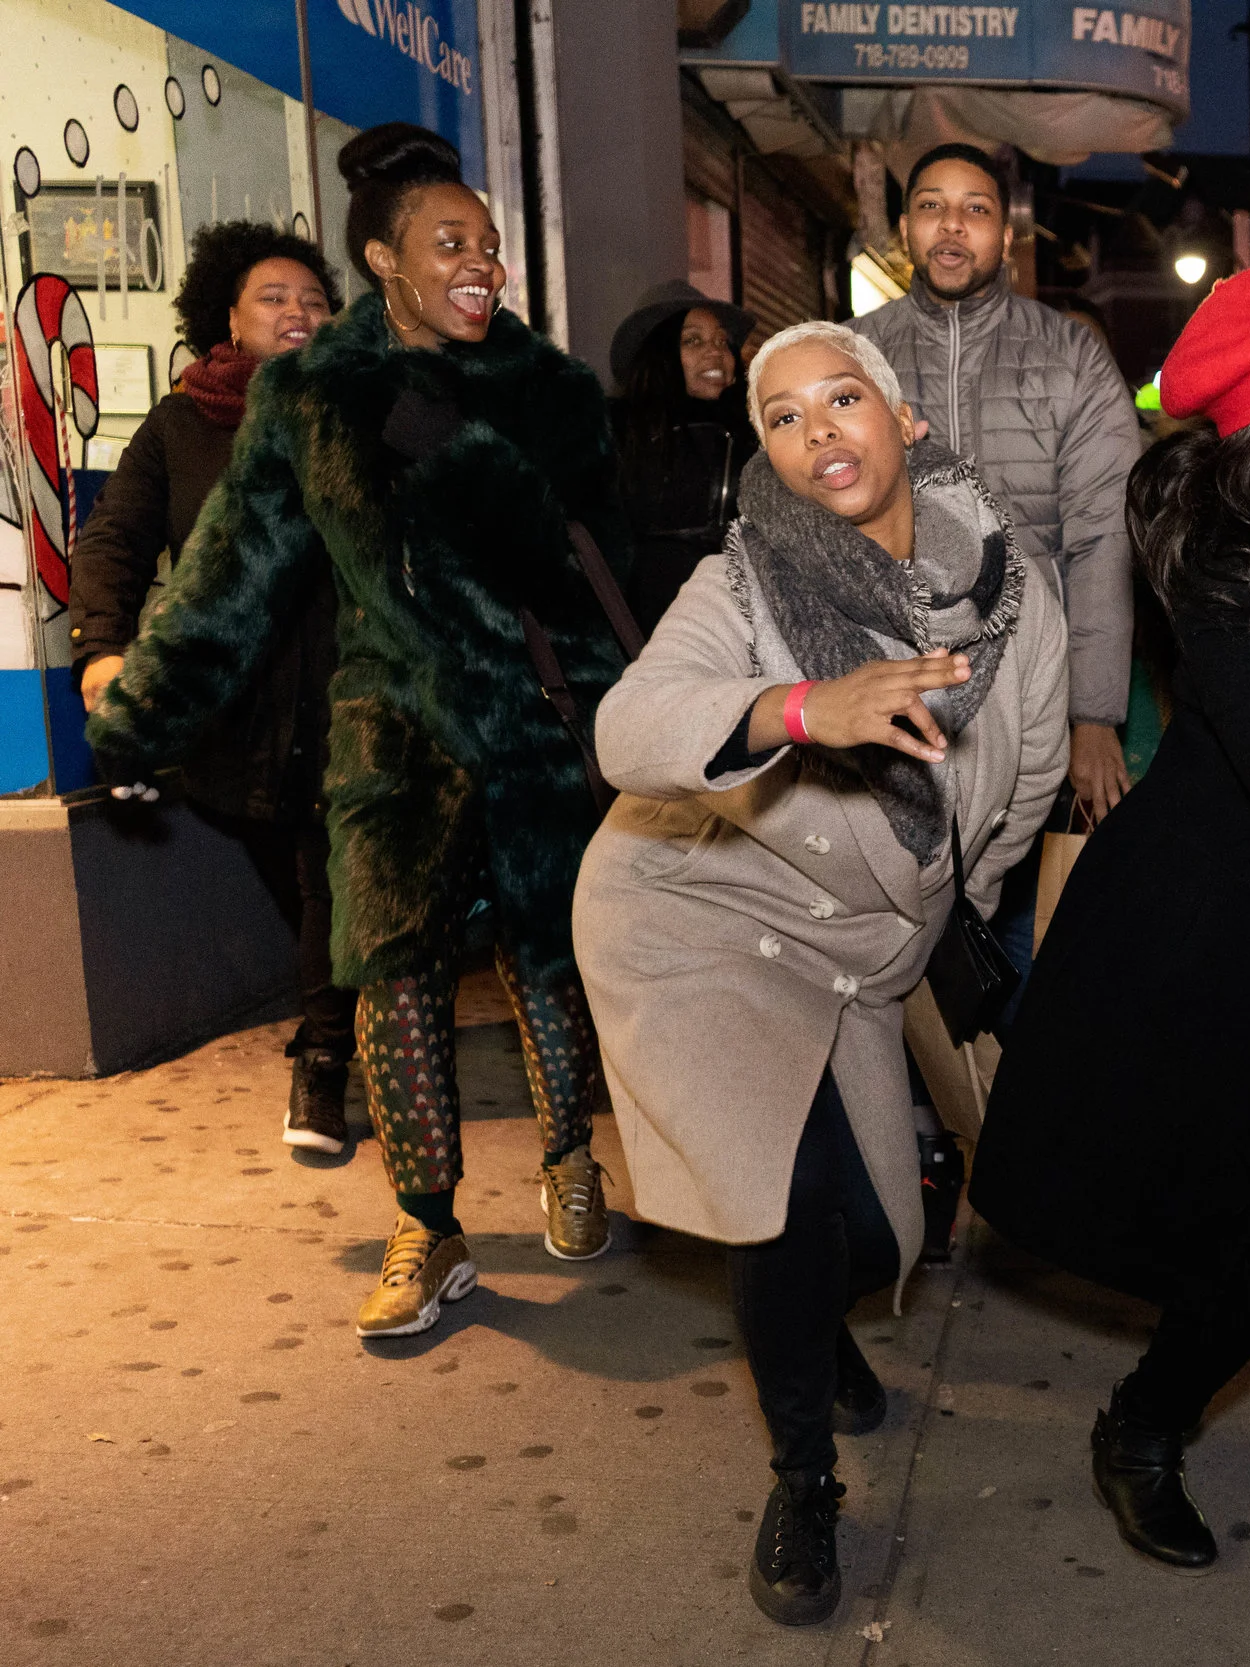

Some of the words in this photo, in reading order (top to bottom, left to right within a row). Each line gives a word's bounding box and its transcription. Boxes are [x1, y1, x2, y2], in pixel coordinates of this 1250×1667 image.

[801, 3, 881, 34] FAMILY
[887, 5, 1018, 38] DENTISTRY
[1072, 7, 1181, 57] FAMILY
[374, 0, 472, 95] WellCare
